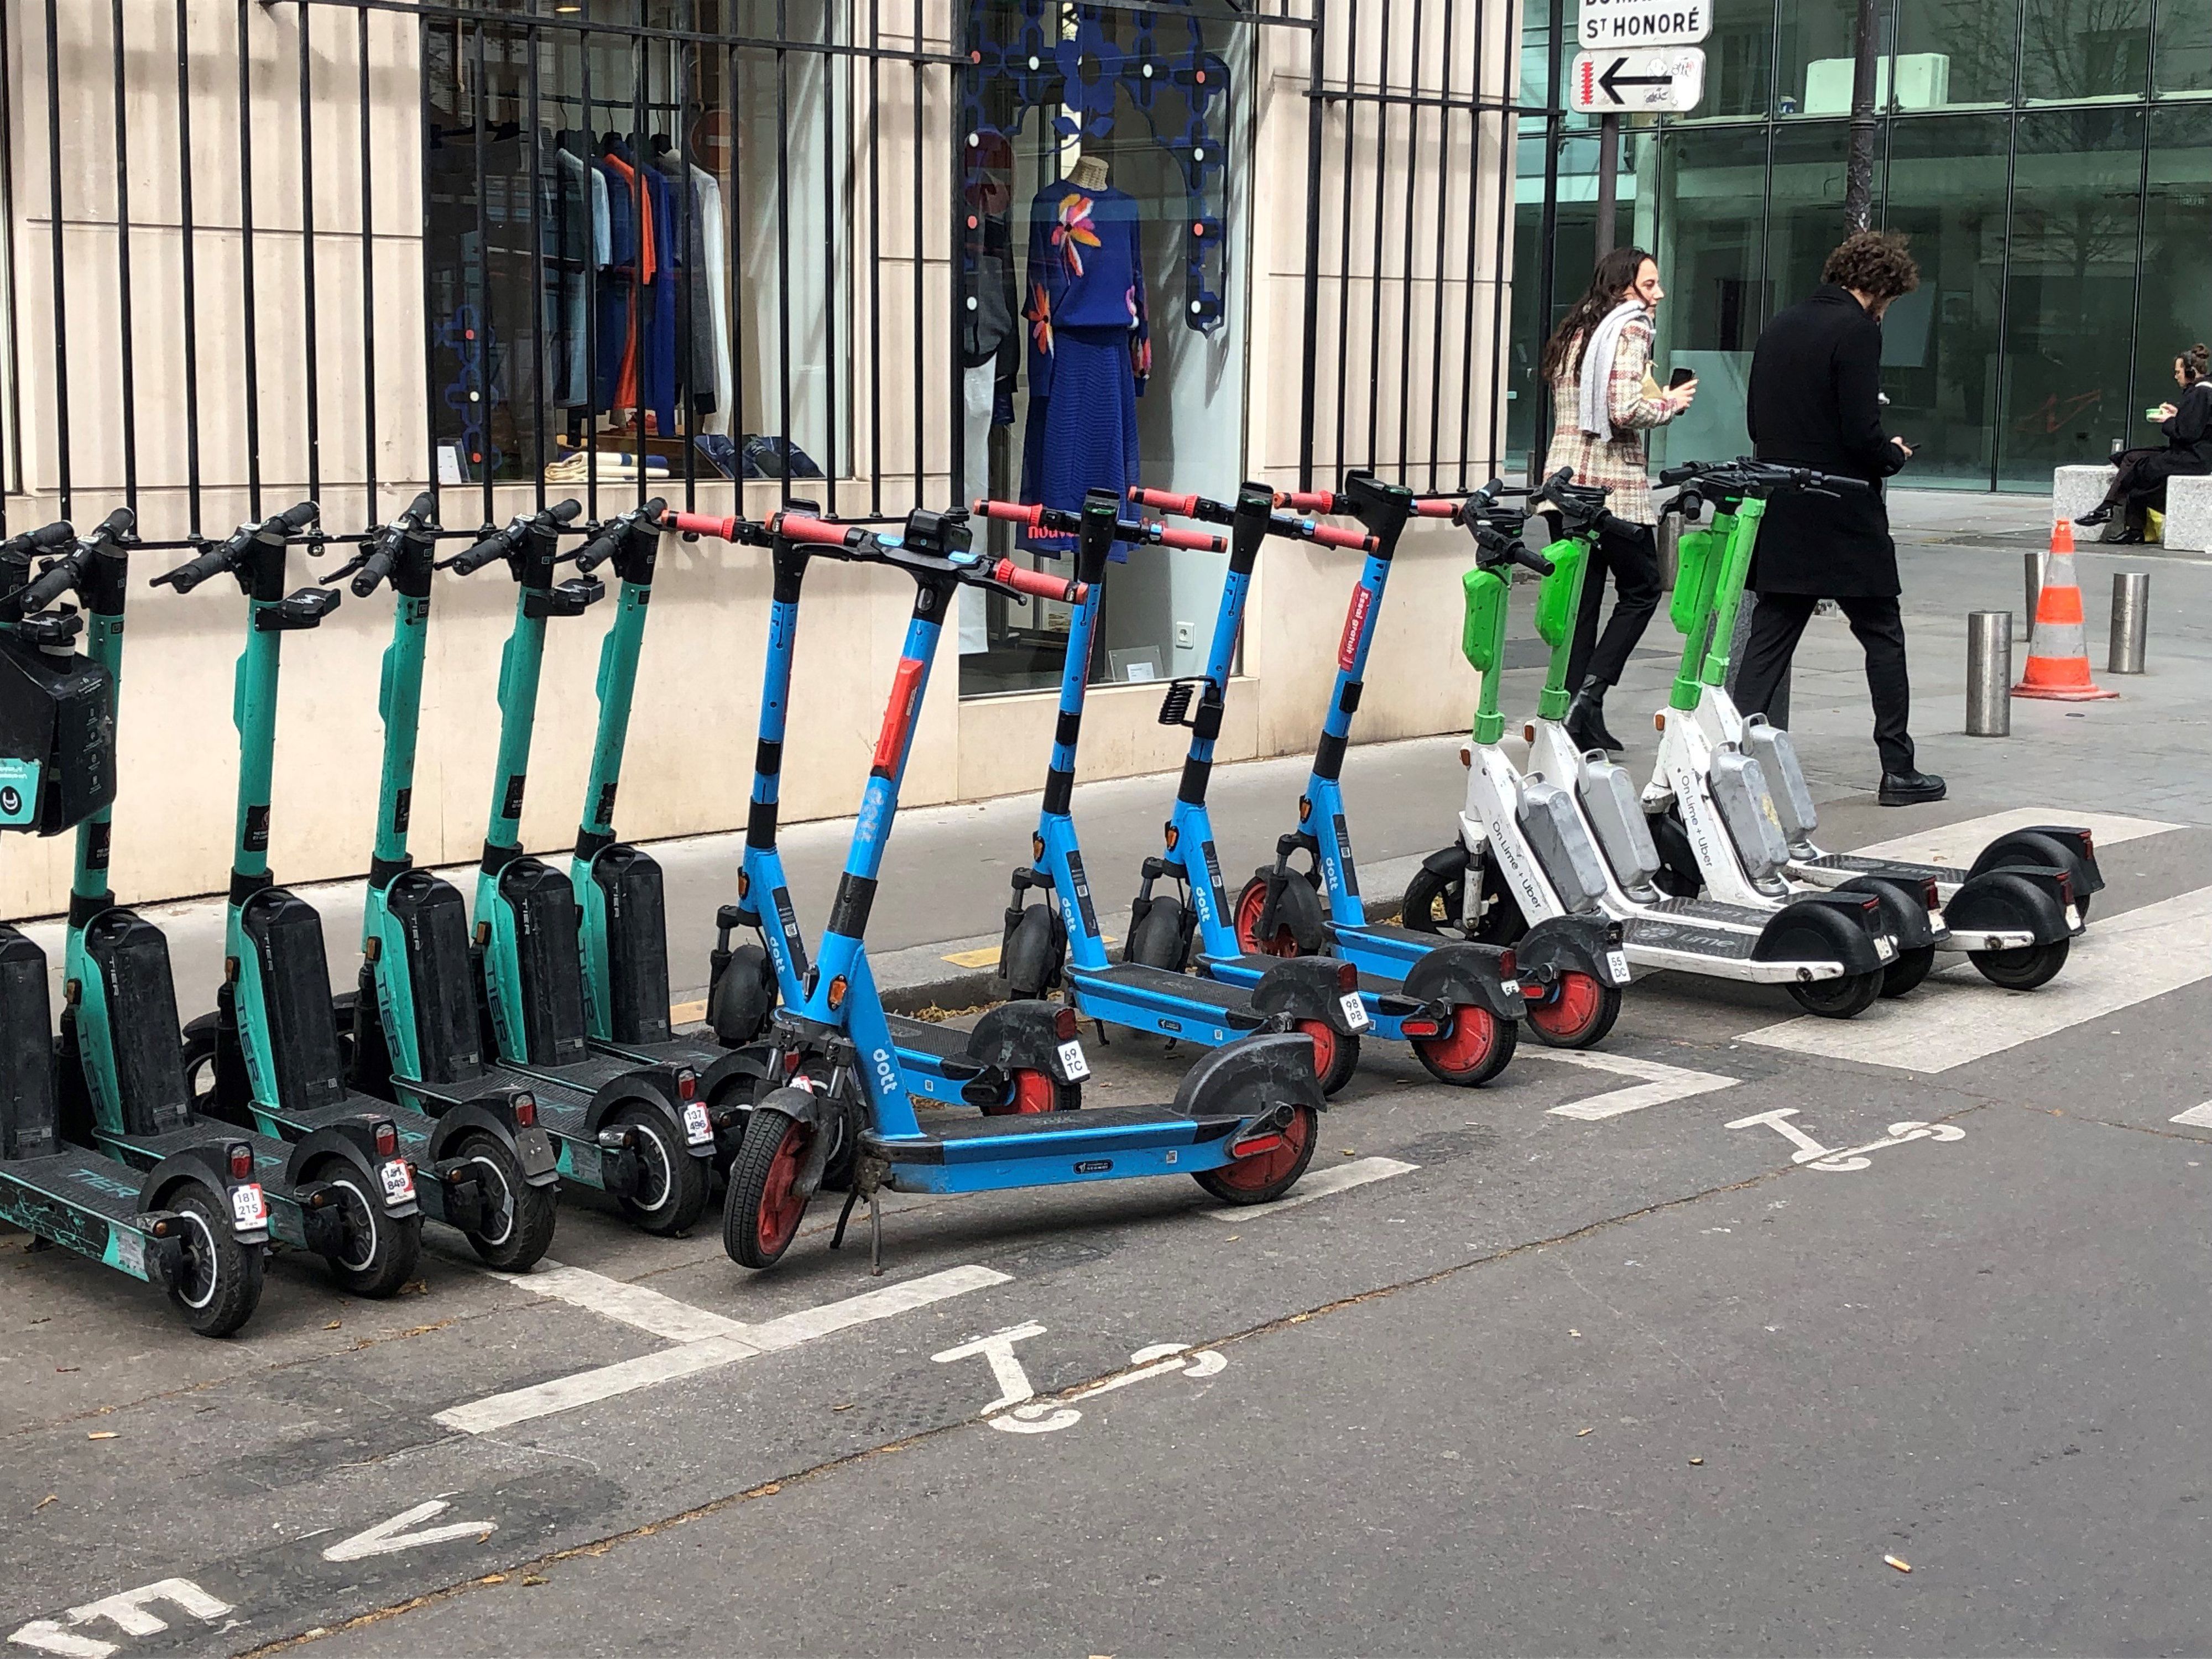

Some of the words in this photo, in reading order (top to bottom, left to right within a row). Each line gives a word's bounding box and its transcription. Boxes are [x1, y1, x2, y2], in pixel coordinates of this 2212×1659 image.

[1614, 7, 1699, 36] HONORÉ
[1682, 775, 1690, 795] On
[1686, 795, 1699, 826] Lime
[1698, 837, 1712, 867] Uber
[1326, 857, 1339, 891] dott
[1493, 821, 1503, 841] On
[1501, 840, 1519, 870] Lime
[1522, 878, 1542, 908] Uber
[1062, 897, 1076, 933] dott
[1196, 886, 1211, 922] dott
[770, 936, 785, 974] dott
[1612, 957, 1622, 967] 55
[1614, 968, 1627, 978] DC
[378, 972, 400, 1061] TIER
[487, 960, 508, 1042] TIER
[1346, 999, 1359, 1011] 98
[1350, 1010, 1363, 1022] PB
[237, 994, 259, 1081] TIER
[80, 1022, 104, 1110] TIER
[1065, 1048, 1077, 1061] 69
[1067, 1061, 1083, 1074] TC
[873, 1048, 898, 1094] dott
[687, 1110, 701, 1120] 137
[67, 1168, 141, 1198] TIER
[238, 1192, 255, 1203] 181
[238, 1203, 258, 1215] 215
